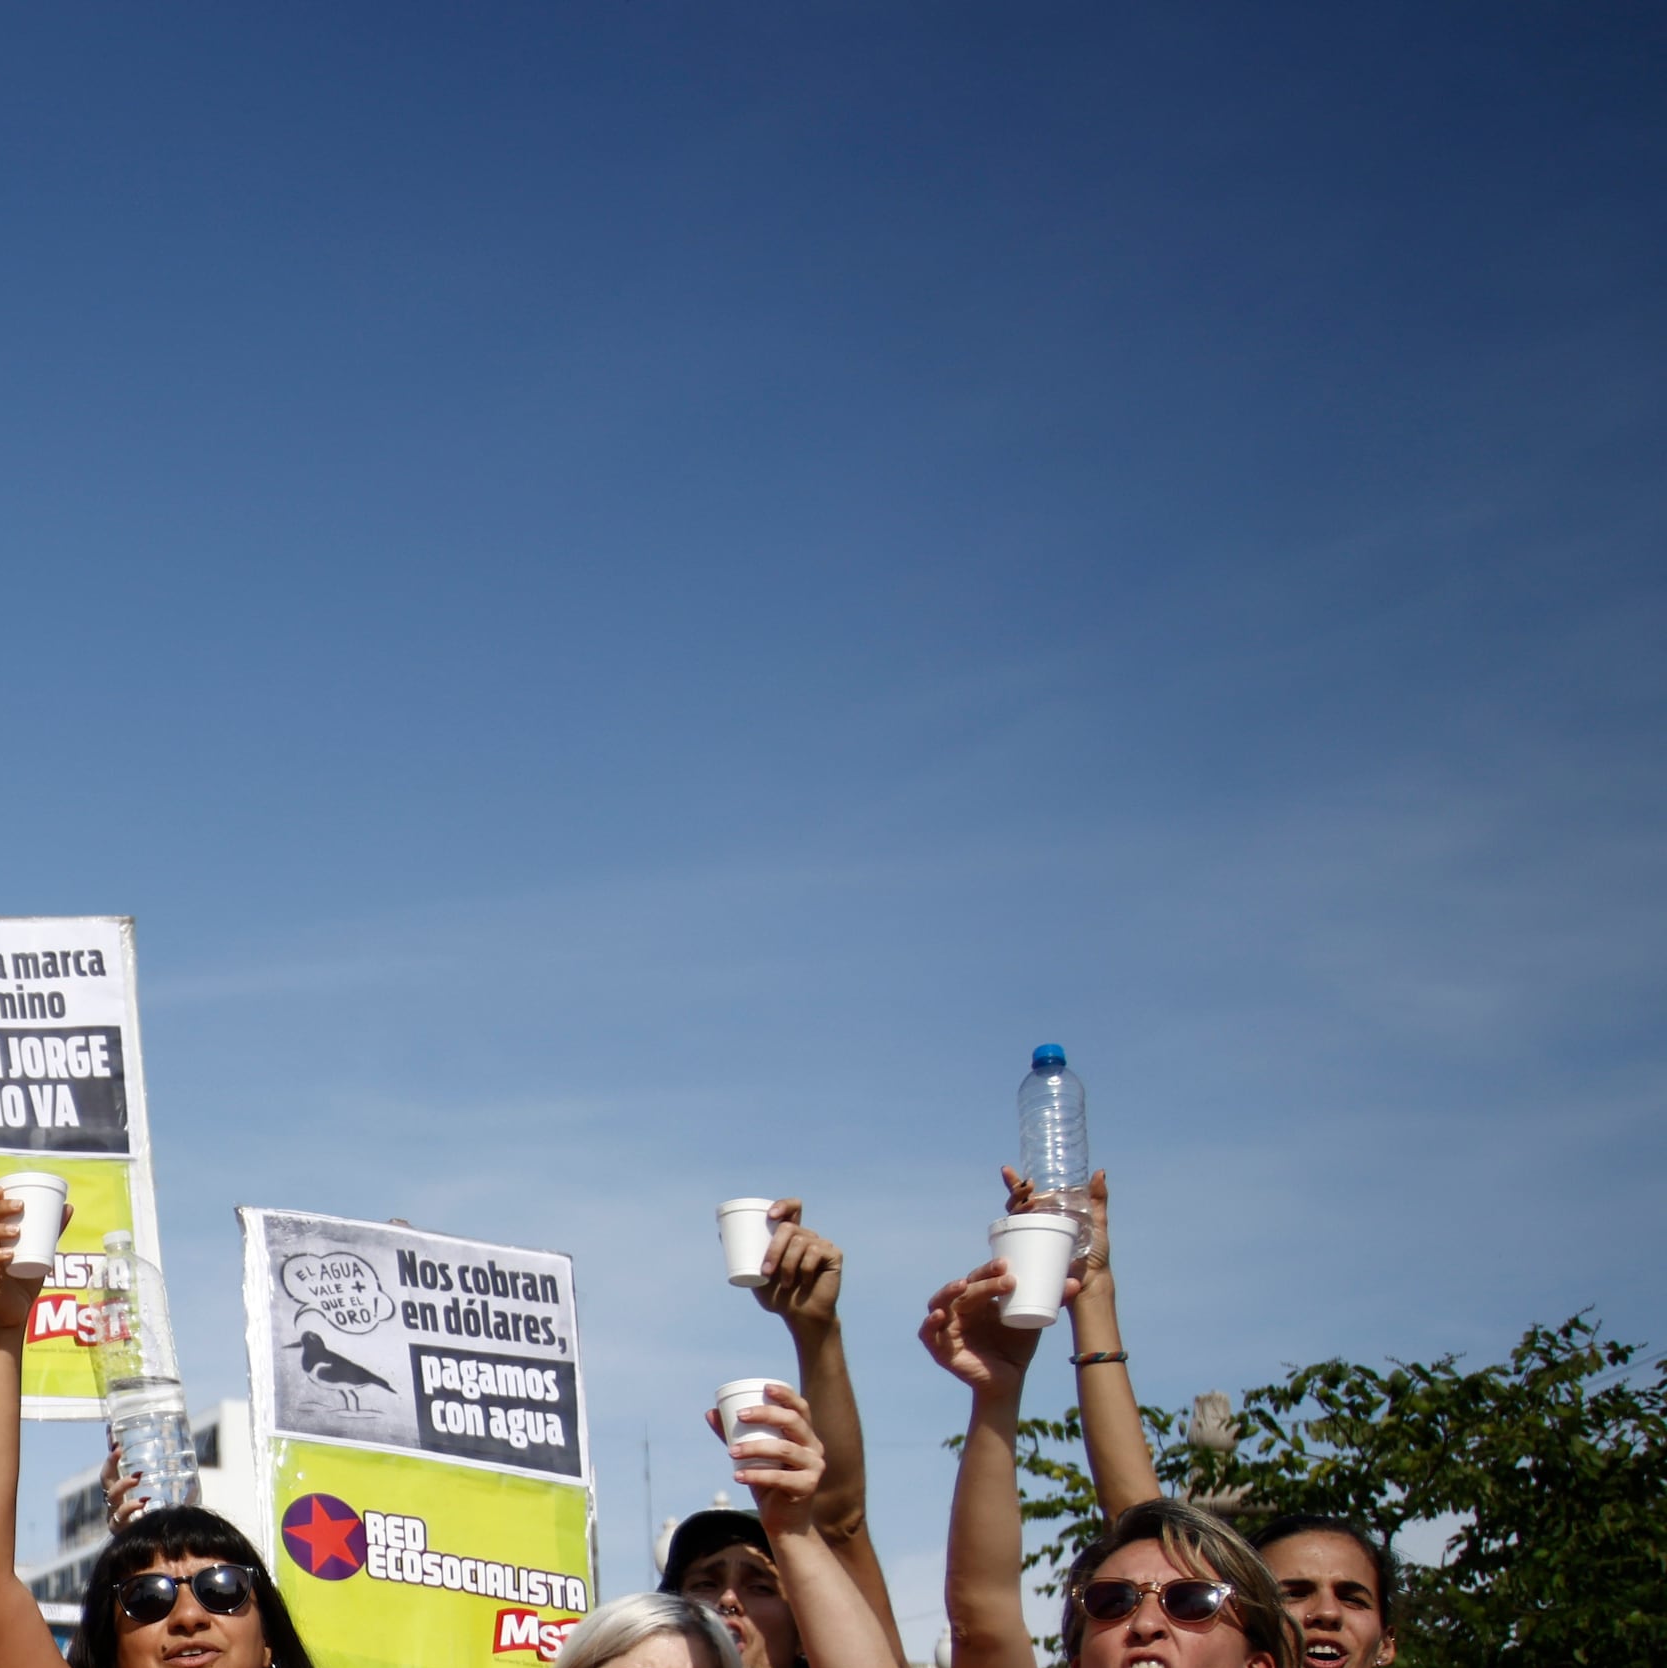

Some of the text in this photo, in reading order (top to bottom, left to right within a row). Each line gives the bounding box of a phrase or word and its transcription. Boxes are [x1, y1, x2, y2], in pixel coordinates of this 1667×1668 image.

[13, 948, 106, 979] marca
[8, 1035, 111, 1079] JORGE
[31, 1085, 80, 1128] VA
[295, 1262, 364, 1282] EL AGUA
[309, 1283, 344, 1296] VALE
[396, 1249, 559, 1305] Nos cobran
[321, 1296, 364, 1311] QUE EL
[402, 1298, 567, 1354] en dólares,
[420, 1355, 560, 1402] pagamos
[430, 1399, 565, 1450] con agua
[364, 1511, 426, 1553] RED
[365, 1545, 588, 1613] ECOSOCIALISTA
